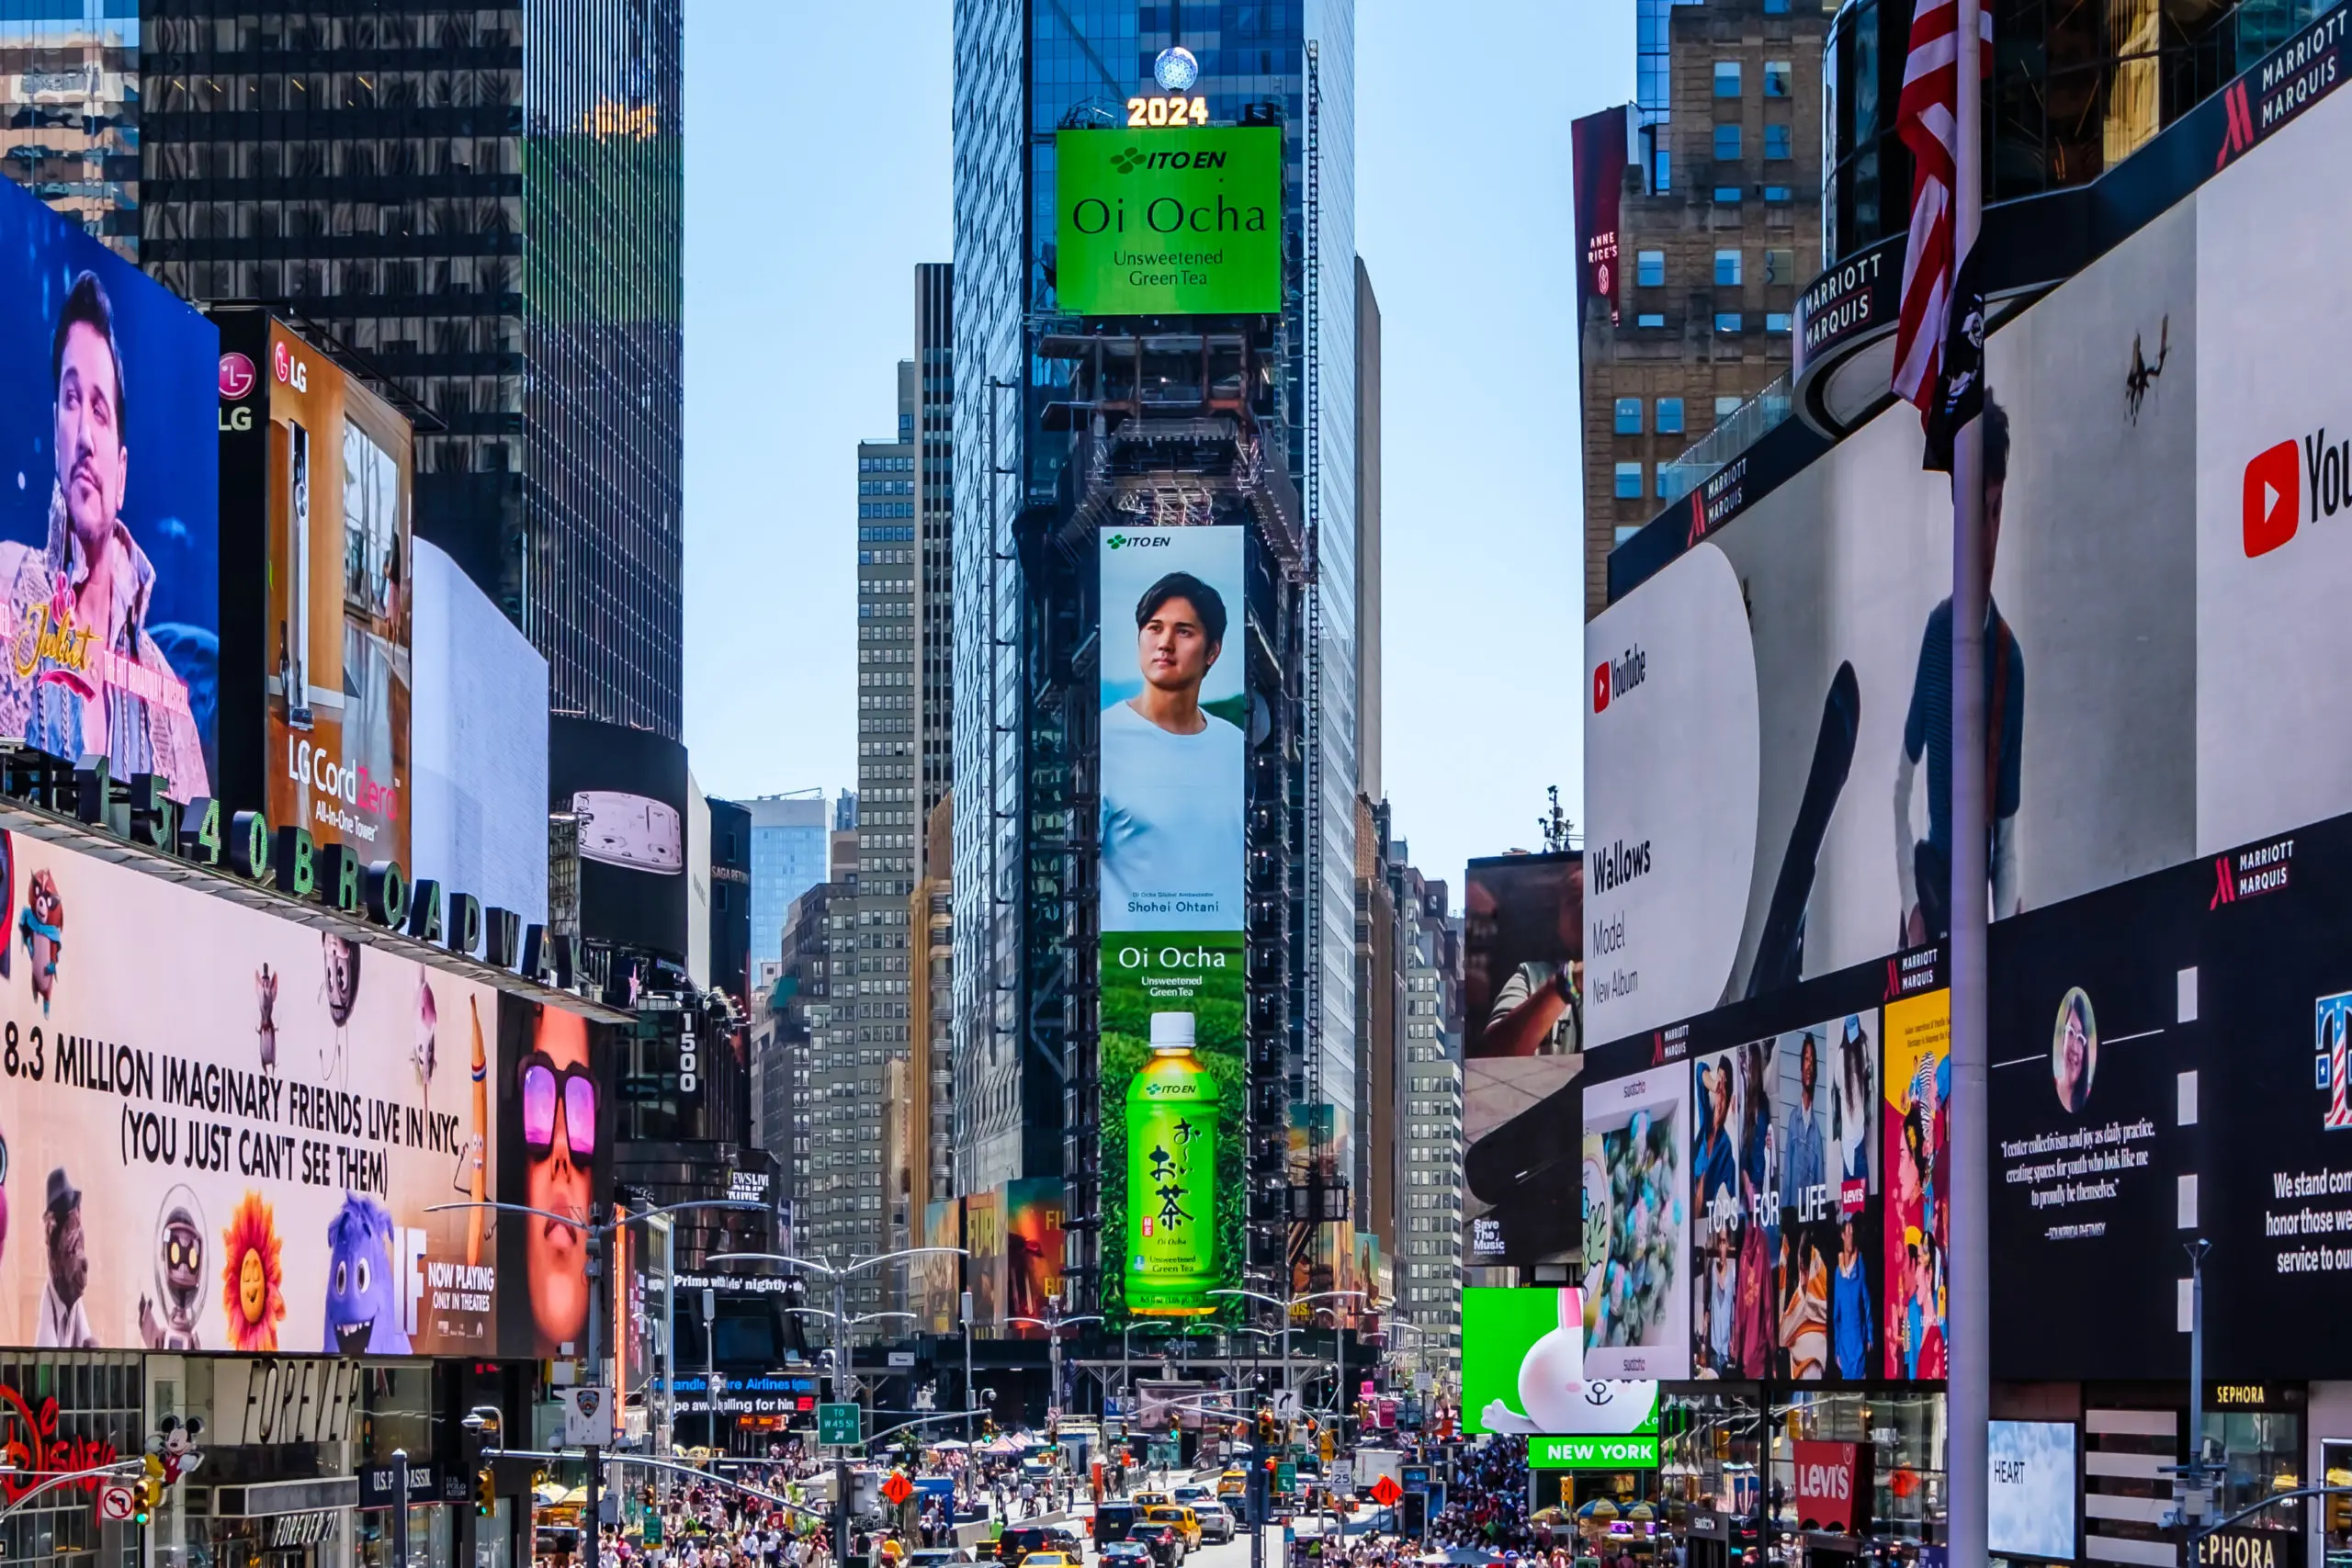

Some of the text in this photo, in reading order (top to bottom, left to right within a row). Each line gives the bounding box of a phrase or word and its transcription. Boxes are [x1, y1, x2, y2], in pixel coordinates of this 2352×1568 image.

[2262, 8, 2347, 92] MARRIOTT
[2262, 55, 2335, 129] MARQUIS
[1127, 96, 1208, 127] 2024
[1147, 152, 1227, 169] ITO EN
[1073, 193, 1266, 234] Oi Ocha
[1588, 244, 1618, 264] RICE'S
[1589, 231, 1615, 249] ANNE
[1114, 249, 1223, 266] Unsweetened
[1129, 271, 1207, 286] Green Tea
[1805, 253, 1882, 319] MARRIOTT
[1805, 294, 1869, 353] MARQUIS
[290, 355, 307, 393] LG
[218, 406, 252, 431] LG
[1708, 457, 1747, 500] MARRIOTT
[1708, 487, 1742, 524] MARQUIS
[1126, 536, 1170, 547] ITO EN
[14, 603, 104, 677] Juliet
[1611, 643, 1645, 702] YouTube
[288, 734, 311, 784] LG
[354, 815, 376, 842] Tower
[1592, 840, 1652, 896] Wallows
[2239, 840, 2294, 872] MARRIOTT
[81, 753, 582, 989] 1540 BROADWAY
[2239, 866, 2287, 896] MARQUIS
[1127, 901, 1219, 912] Shohei Ohtani
[1592, 910, 1625, 959] Model
[1118, 945, 1226, 968] Oi Ocha
[1902, 948, 1938, 971] MARRIOTT
[1141, 975, 1203, 986] Unsweetened
[1149, 987, 1193, 998] Green Tea
[1592, 969, 1638, 1006] New Album
[1902, 970, 1934, 991] MARQUIS
[1664, 1024, 1689, 1043] MARRIOTT
[680, 1013, 696, 1092] 1500
[1664, 1041, 1687, 1056] MARQUIS
[4, 1021, 44, 1082] 8.3
[55, 1032, 153, 1100] MILLION
[163, 1055, 283, 1122] IMAGINARY
[289, 1081, 363, 1138] FRIENDS
[368, 1098, 401, 1145] LIVE
[406, 1106, 424, 1148] IN
[1161, 1085, 1196, 1094] ITO EN
[121, 1102, 388, 1201] (YOU JUST CAN'T SEE THEM)
[2029, 1131, 2068, 1154] collectivism
[2068, 1127, 2084, 1148] and
[2083, 1127, 2093, 1149] joy
[2094, 1130, 2103, 1145] as
[2104, 1121, 2122, 1145] daily
[2006, 1147, 2149, 1184] creating spaces for youth who look like me
[1148, 1145, 1196, 1231] お茶
[2031, 1189, 2040, 1206] to
[2040, 1183, 2065, 1209] proudly
[2066, 1183, 2075, 1202] be
[2273, 1171, 2294, 1200] We
[2294, 1167, 2328, 1198] stand
[1706, 1197, 1738, 1234] TOPS
[1753, 1190, 1780, 1228] FOR
[1798, 1184, 1826, 1224] LIFE
[1474, 1218, 1499, 1230] Save
[1474, 1229, 1495, 1240] The
[2266, 1210, 2299, 1237] honor
[2300, 1207, 2335, 1234] those
[1474, 1235, 1505, 1250] Music
[1149, 1255, 1196, 1263] Unsweetened
[1152, 1264, 1194, 1273] Green Tea
[2277, 1244, 2335, 1273] service to
[393, 1226, 426, 1336] IF
[428, 1261, 494, 1292] NOW PLAYING
[673, 1275, 709, 1288] Prime
[745, 1278, 787, 1293] nightly
[433, 1291, 491, 1313] ONLY IN THEATRES
[746, 1378, 790, 1392] Airlines
[2217, 1385, 2265, 1404] SEPHORA
[241, 1359, 361, 1449] FOREVER
[755, 1397, 775, 1411] for
[777, 1397, 795, 1411] him
[833, 1408, 844, 1417] TO
[824, 1419, 831, 1428] W
[832, 1419, 844, 1428] 45
[1547, 1444, 1653, 1460] NEW YORK
[373, 1471, 388, 1491] U.S.
[1334, 1473, 1350, 1484] 25
[1994, 1461, 2025, 1484] HEART
[274, 1511, 338, 1547] FOREVER 21
